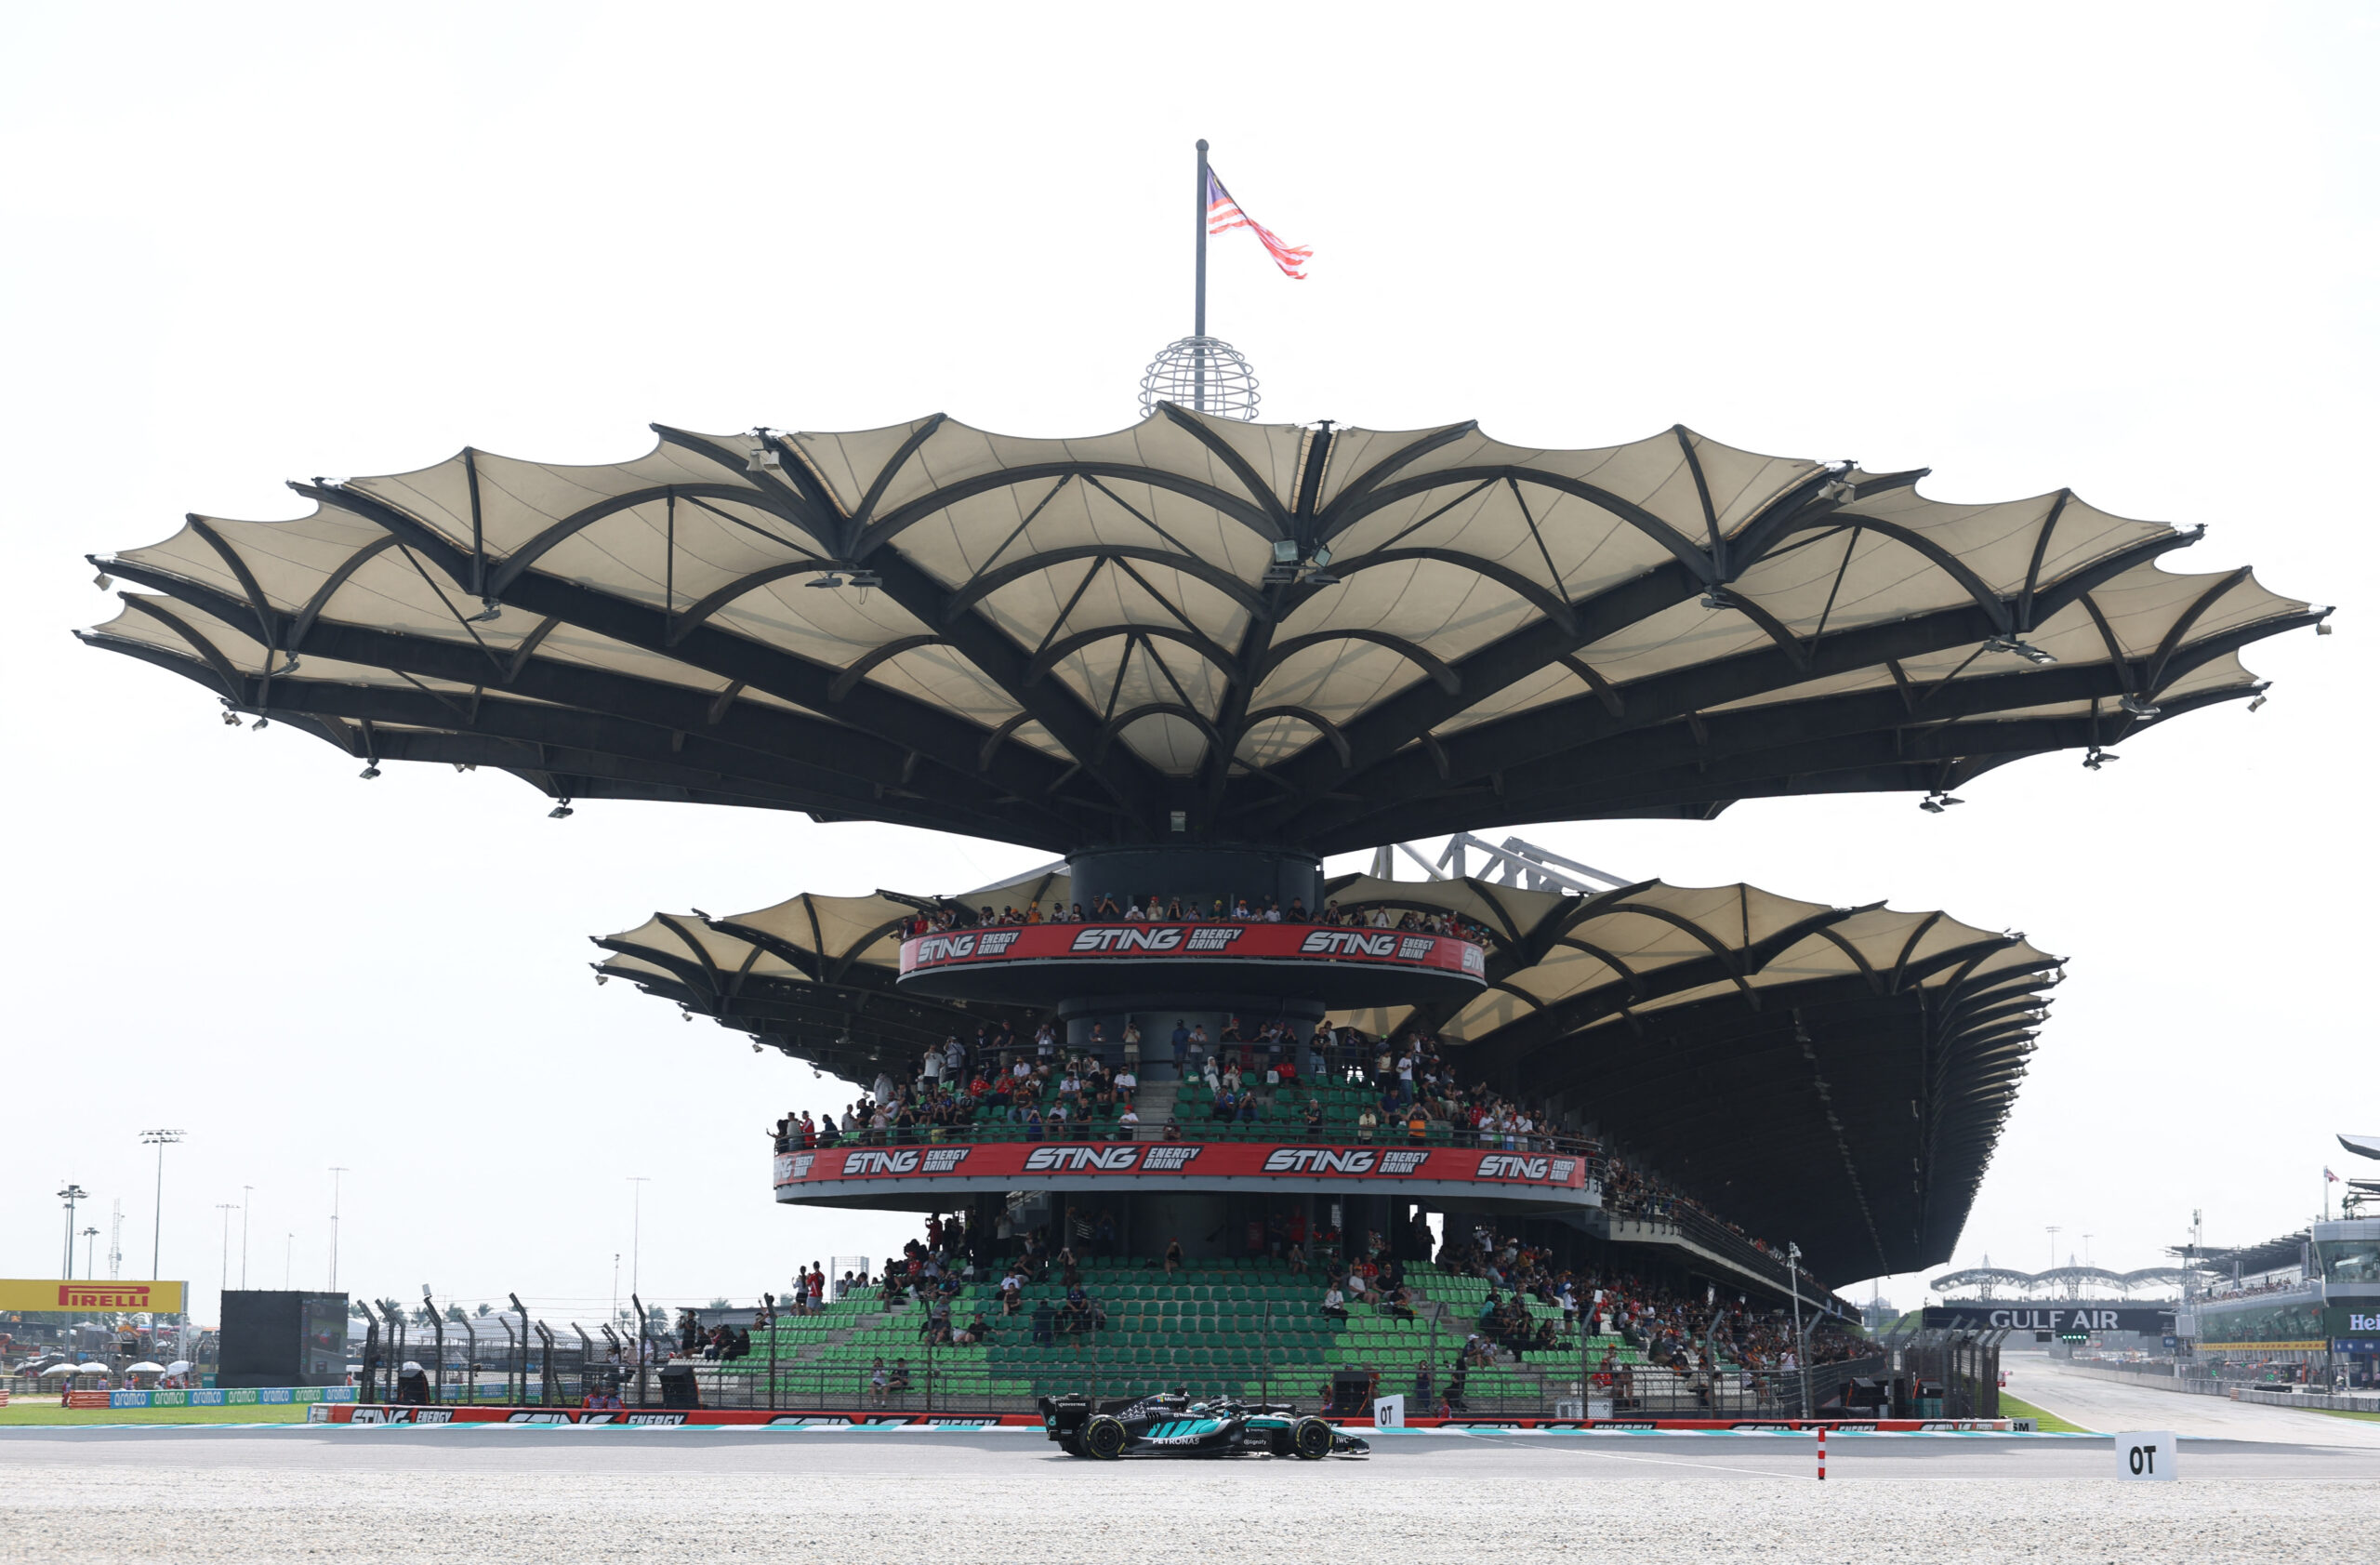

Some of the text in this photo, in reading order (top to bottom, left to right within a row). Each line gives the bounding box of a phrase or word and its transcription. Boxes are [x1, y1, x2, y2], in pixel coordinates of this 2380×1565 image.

[981, 932, 1019, 944] ENERGY
[1072, 929, 1182, 949] STING
[1194, 928, 1242, 939] ENERGY
[919, 935, 974, 962] STING
[977, 943, 1007, 955] DRINK
[1187, 938, 1226, 949] DRINK
[1302, 932, 1395, 955] STING
[1402, 937, 1435, 951] ENERGY
[1398, 947, 1425, 960] DRINK
[929, 1148, 970, 1160] ENERGY
[1025, 1147, 1137, 1169] STING
[1148, 1147, 1200, 1159] ENERGY
[1383, 1152, 1429, 1163] ENERGY
[842, 1151, 919, 1174] STING
[922, 1160, 956, 1172] DRINK
[1143, 1158, 1183, 1169] DRINK
[1264, 1149, 1374, 1173] STING
[1379, 1162, 1415, 1174] DRINK
[1477, 1156, 1548, 1179] STING
[59, 1285, 151, 1306] PIRELLI
[1990, 1310, 2119, 1329] GULF AIR
[114, 1393, 146, 1406] aramco
[154, 1392, 184, 1404] aramco
[192, 1391, 221, 1404] aramco
[229, 1390, 256, 1402] aramco
[263, 1390, 289, 1401] aramco
[296, 1389, 321, 1400] aramco
[326, 1388, 350, 1399] aramco
[417, 1411, 453, 1423] ENERGY
[1381, 1405, 1393, 1425] OT
[2129, 1446, 2156, 1475] OT
